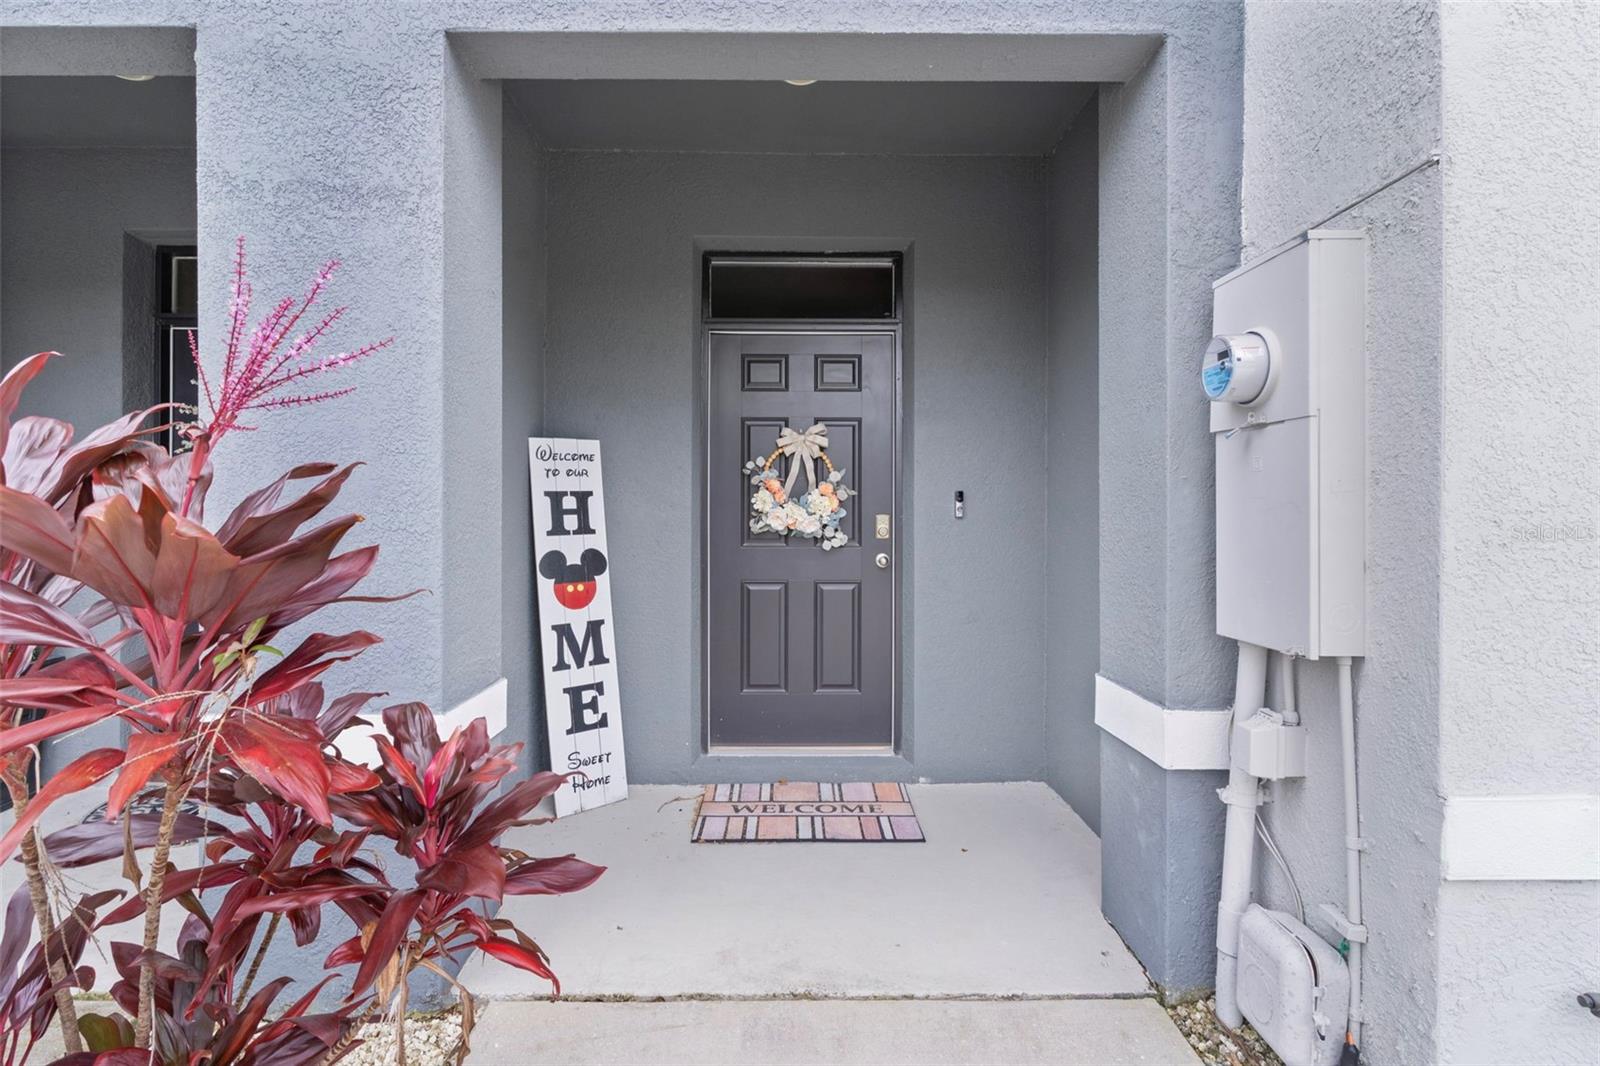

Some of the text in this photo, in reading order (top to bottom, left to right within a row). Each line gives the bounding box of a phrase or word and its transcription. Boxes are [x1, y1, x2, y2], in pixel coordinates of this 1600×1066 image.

[535, 443, 596, 462] WELCOME
[544, 468, 589, 478] TO OUR
[567, 751, 612, 770] SWEET
[731, 803, 884, 814] WELCOME
